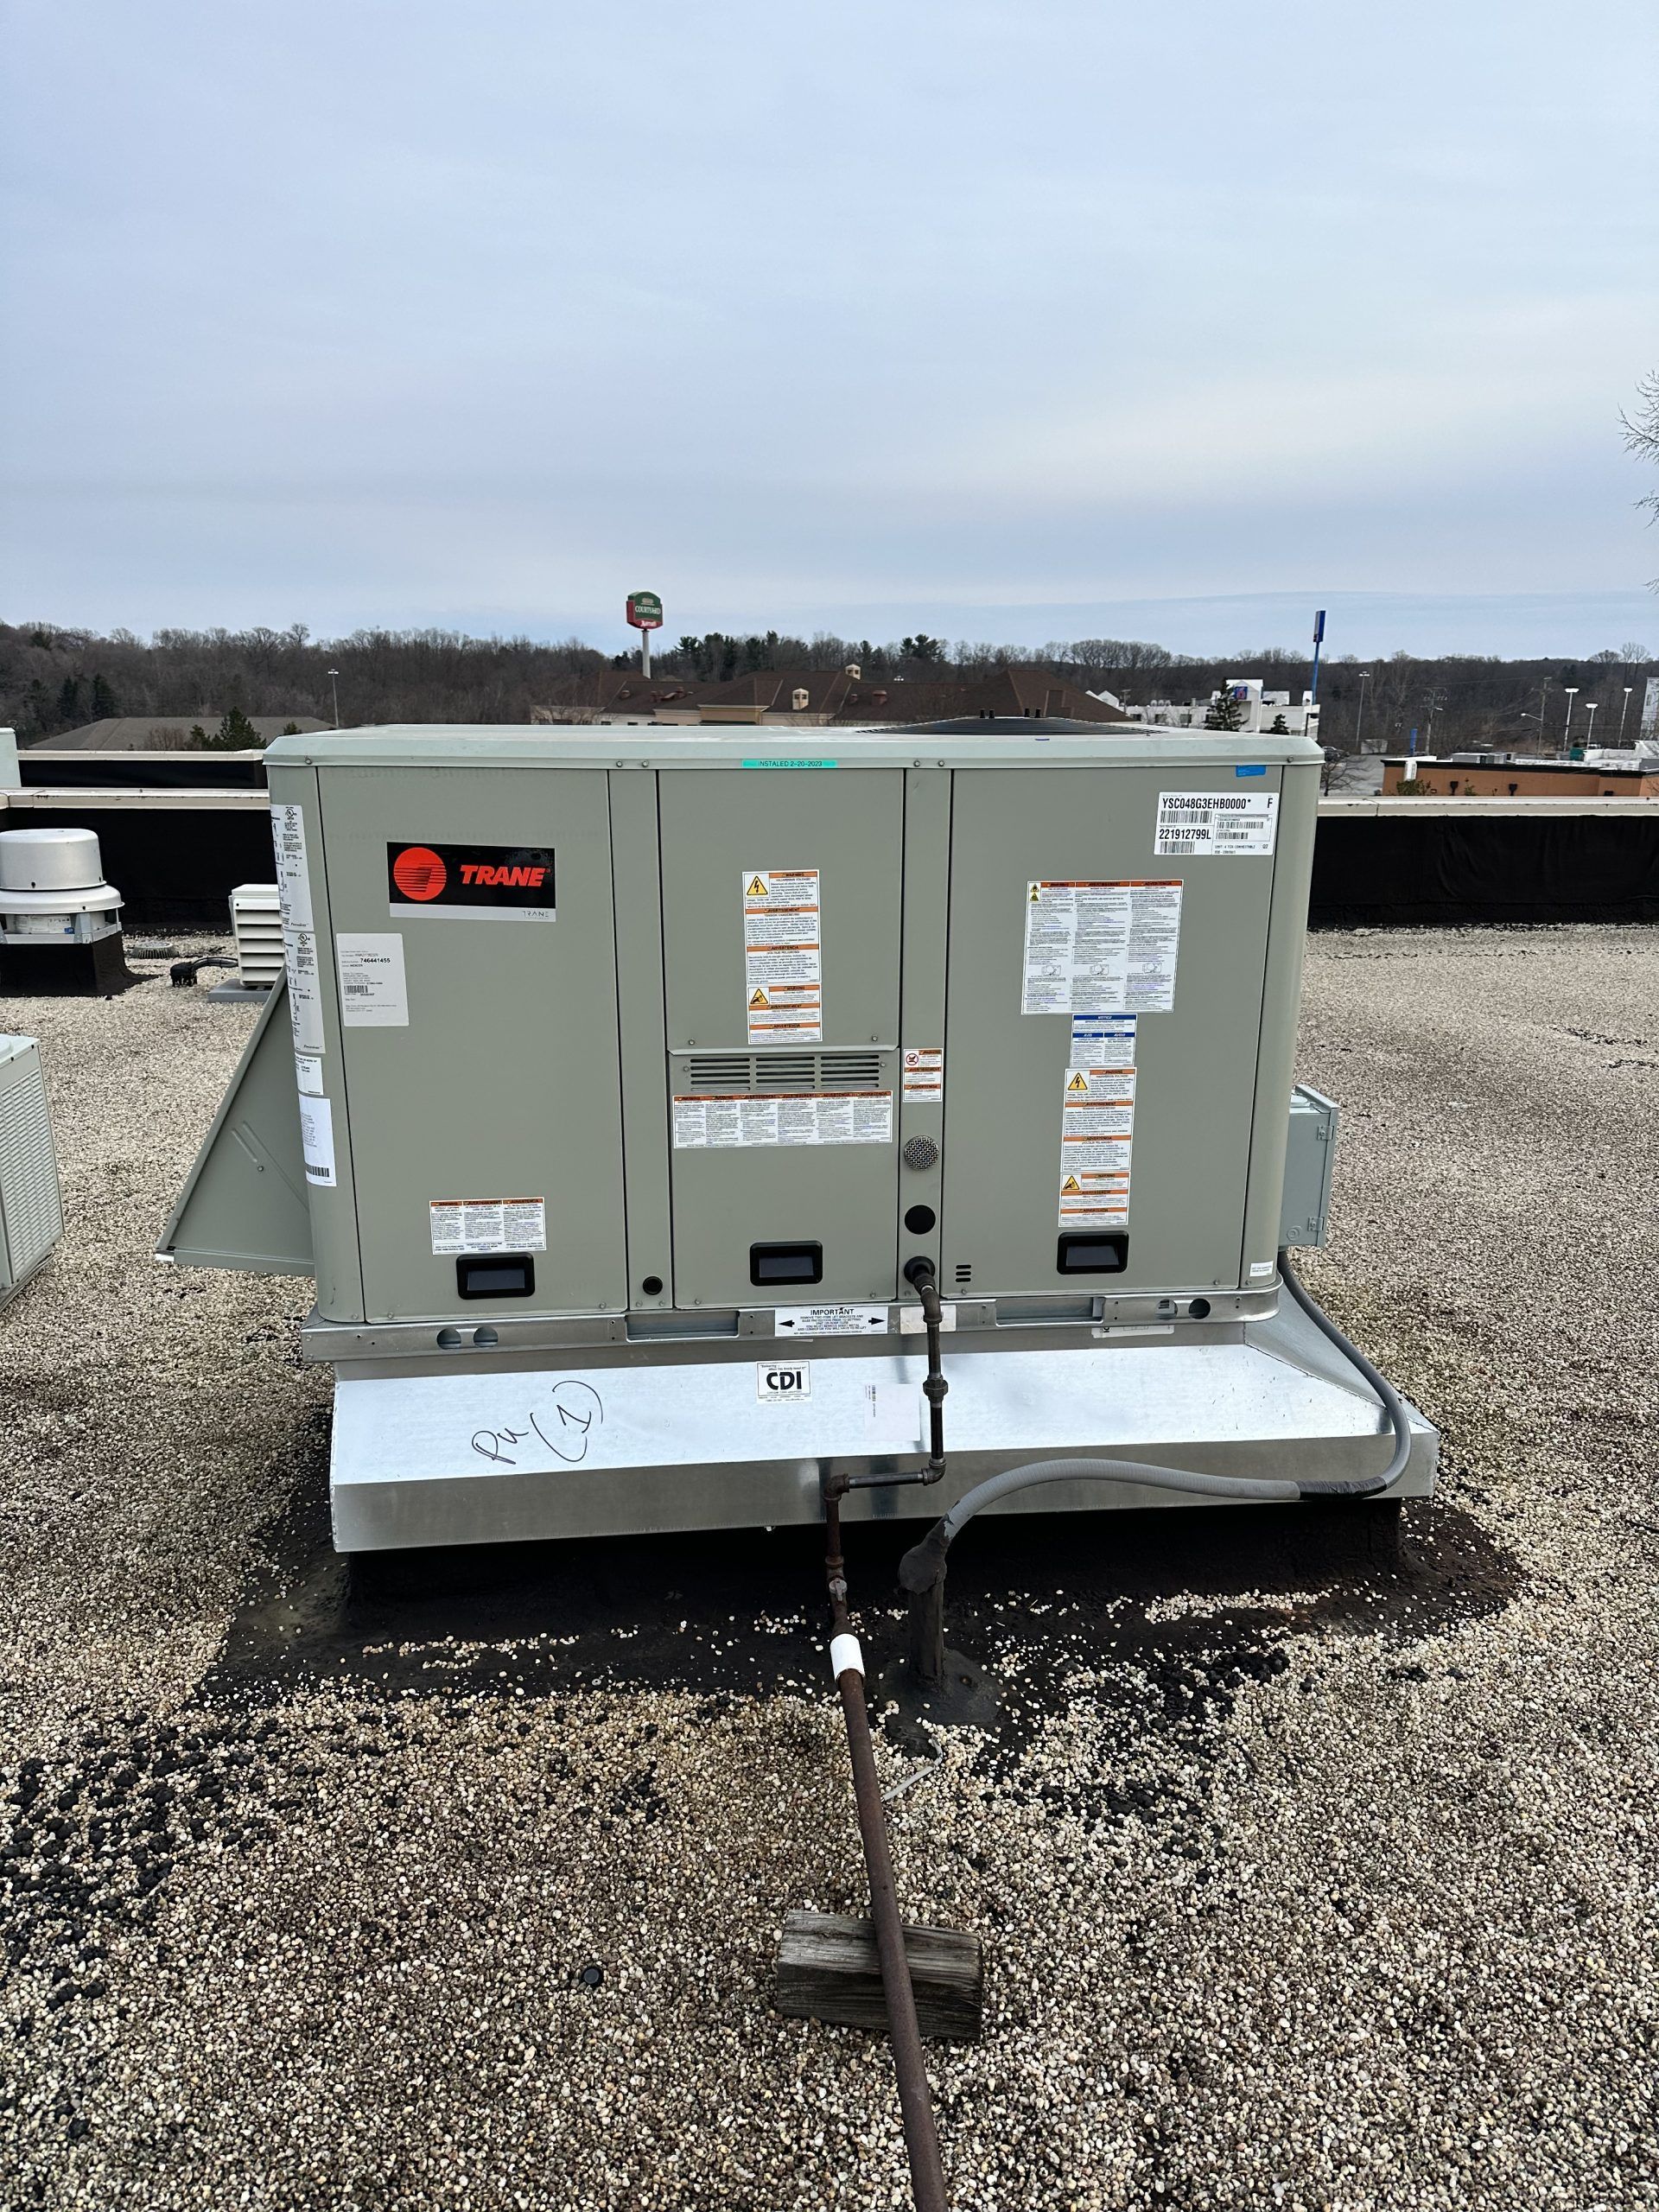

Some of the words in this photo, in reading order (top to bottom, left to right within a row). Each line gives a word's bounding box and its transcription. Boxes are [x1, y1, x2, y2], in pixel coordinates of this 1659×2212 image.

[1267, 798, 1274, 809] F
[1159, 829, 1212, 840] 221912799L
[460, 864, 546, 887] TRANE
[766, 1371, 802, 1390] CDI
